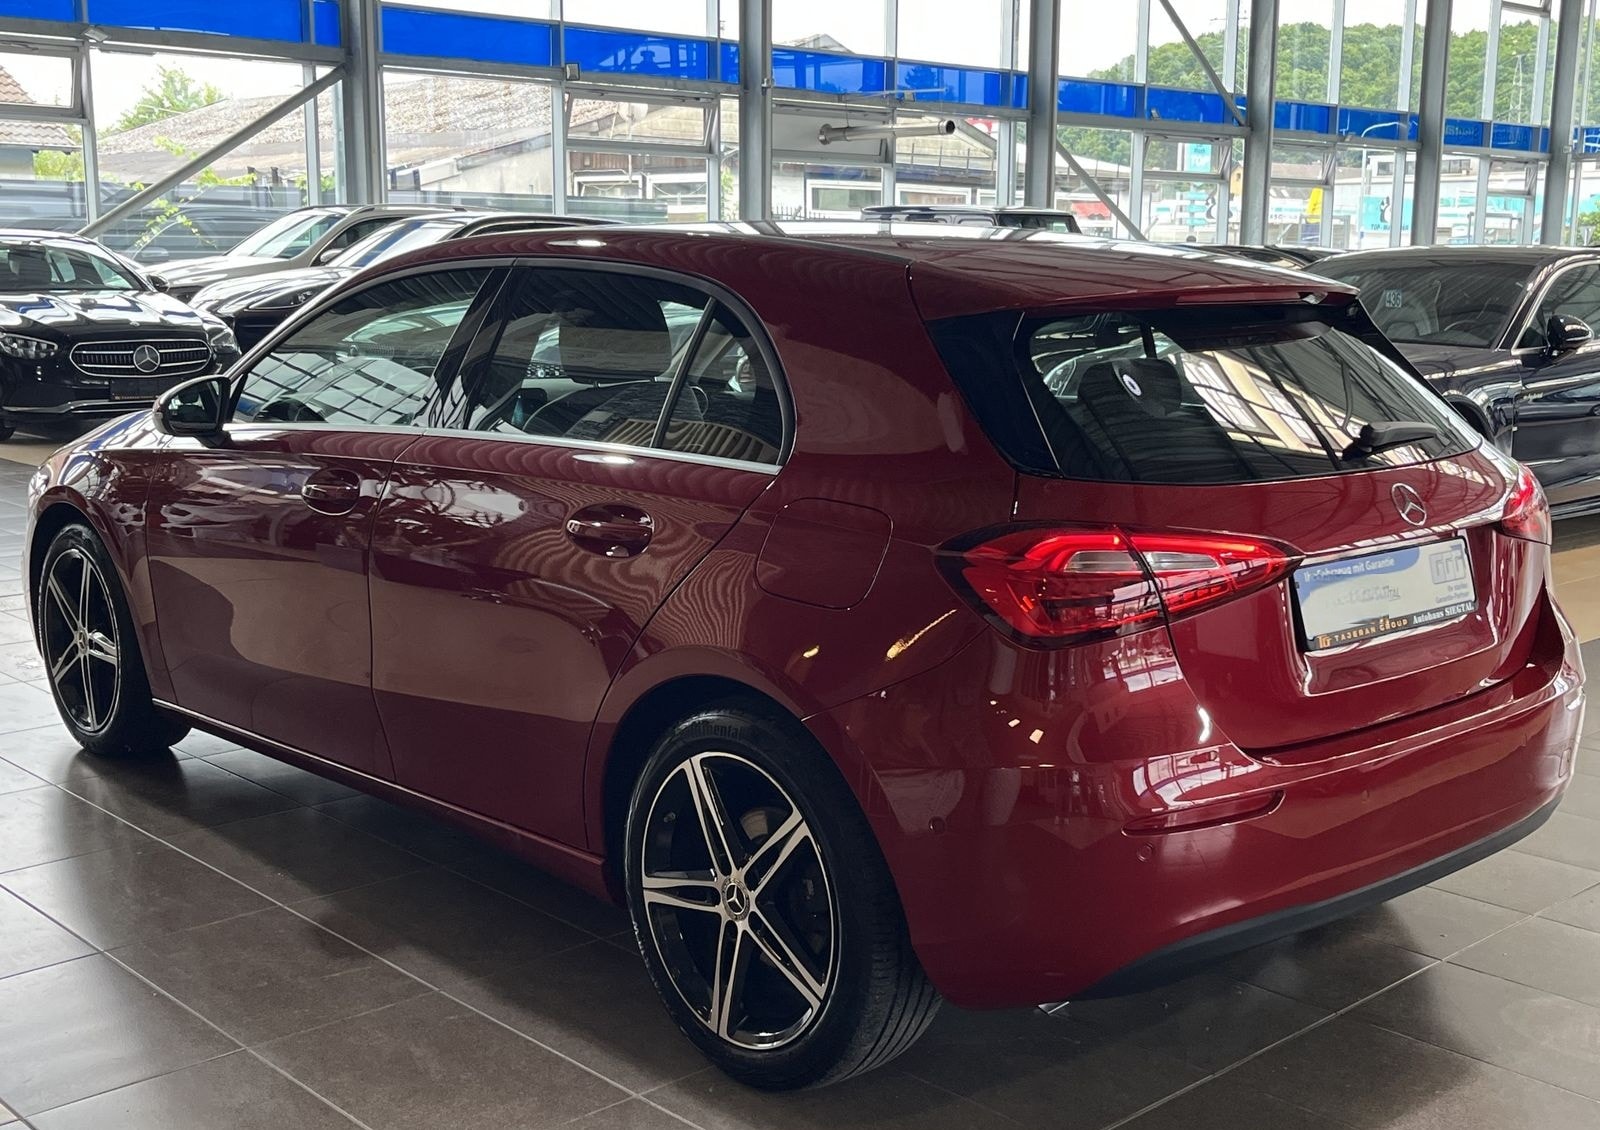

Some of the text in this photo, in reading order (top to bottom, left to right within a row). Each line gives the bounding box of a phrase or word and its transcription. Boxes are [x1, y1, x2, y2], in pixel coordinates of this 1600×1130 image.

[1387, 292, 1401, 307] 436
[1352, 562, 1365, 572] mit
[1365, 557, 1395, 570] Garantie
[1334, 626, 1376, 642] TAJERAN
[1379, 619, 1408, 632] GROUP
[1412, 611, 1444, 625] Autohaus
[1444, 602, 1475, 617] SIEGTAL
